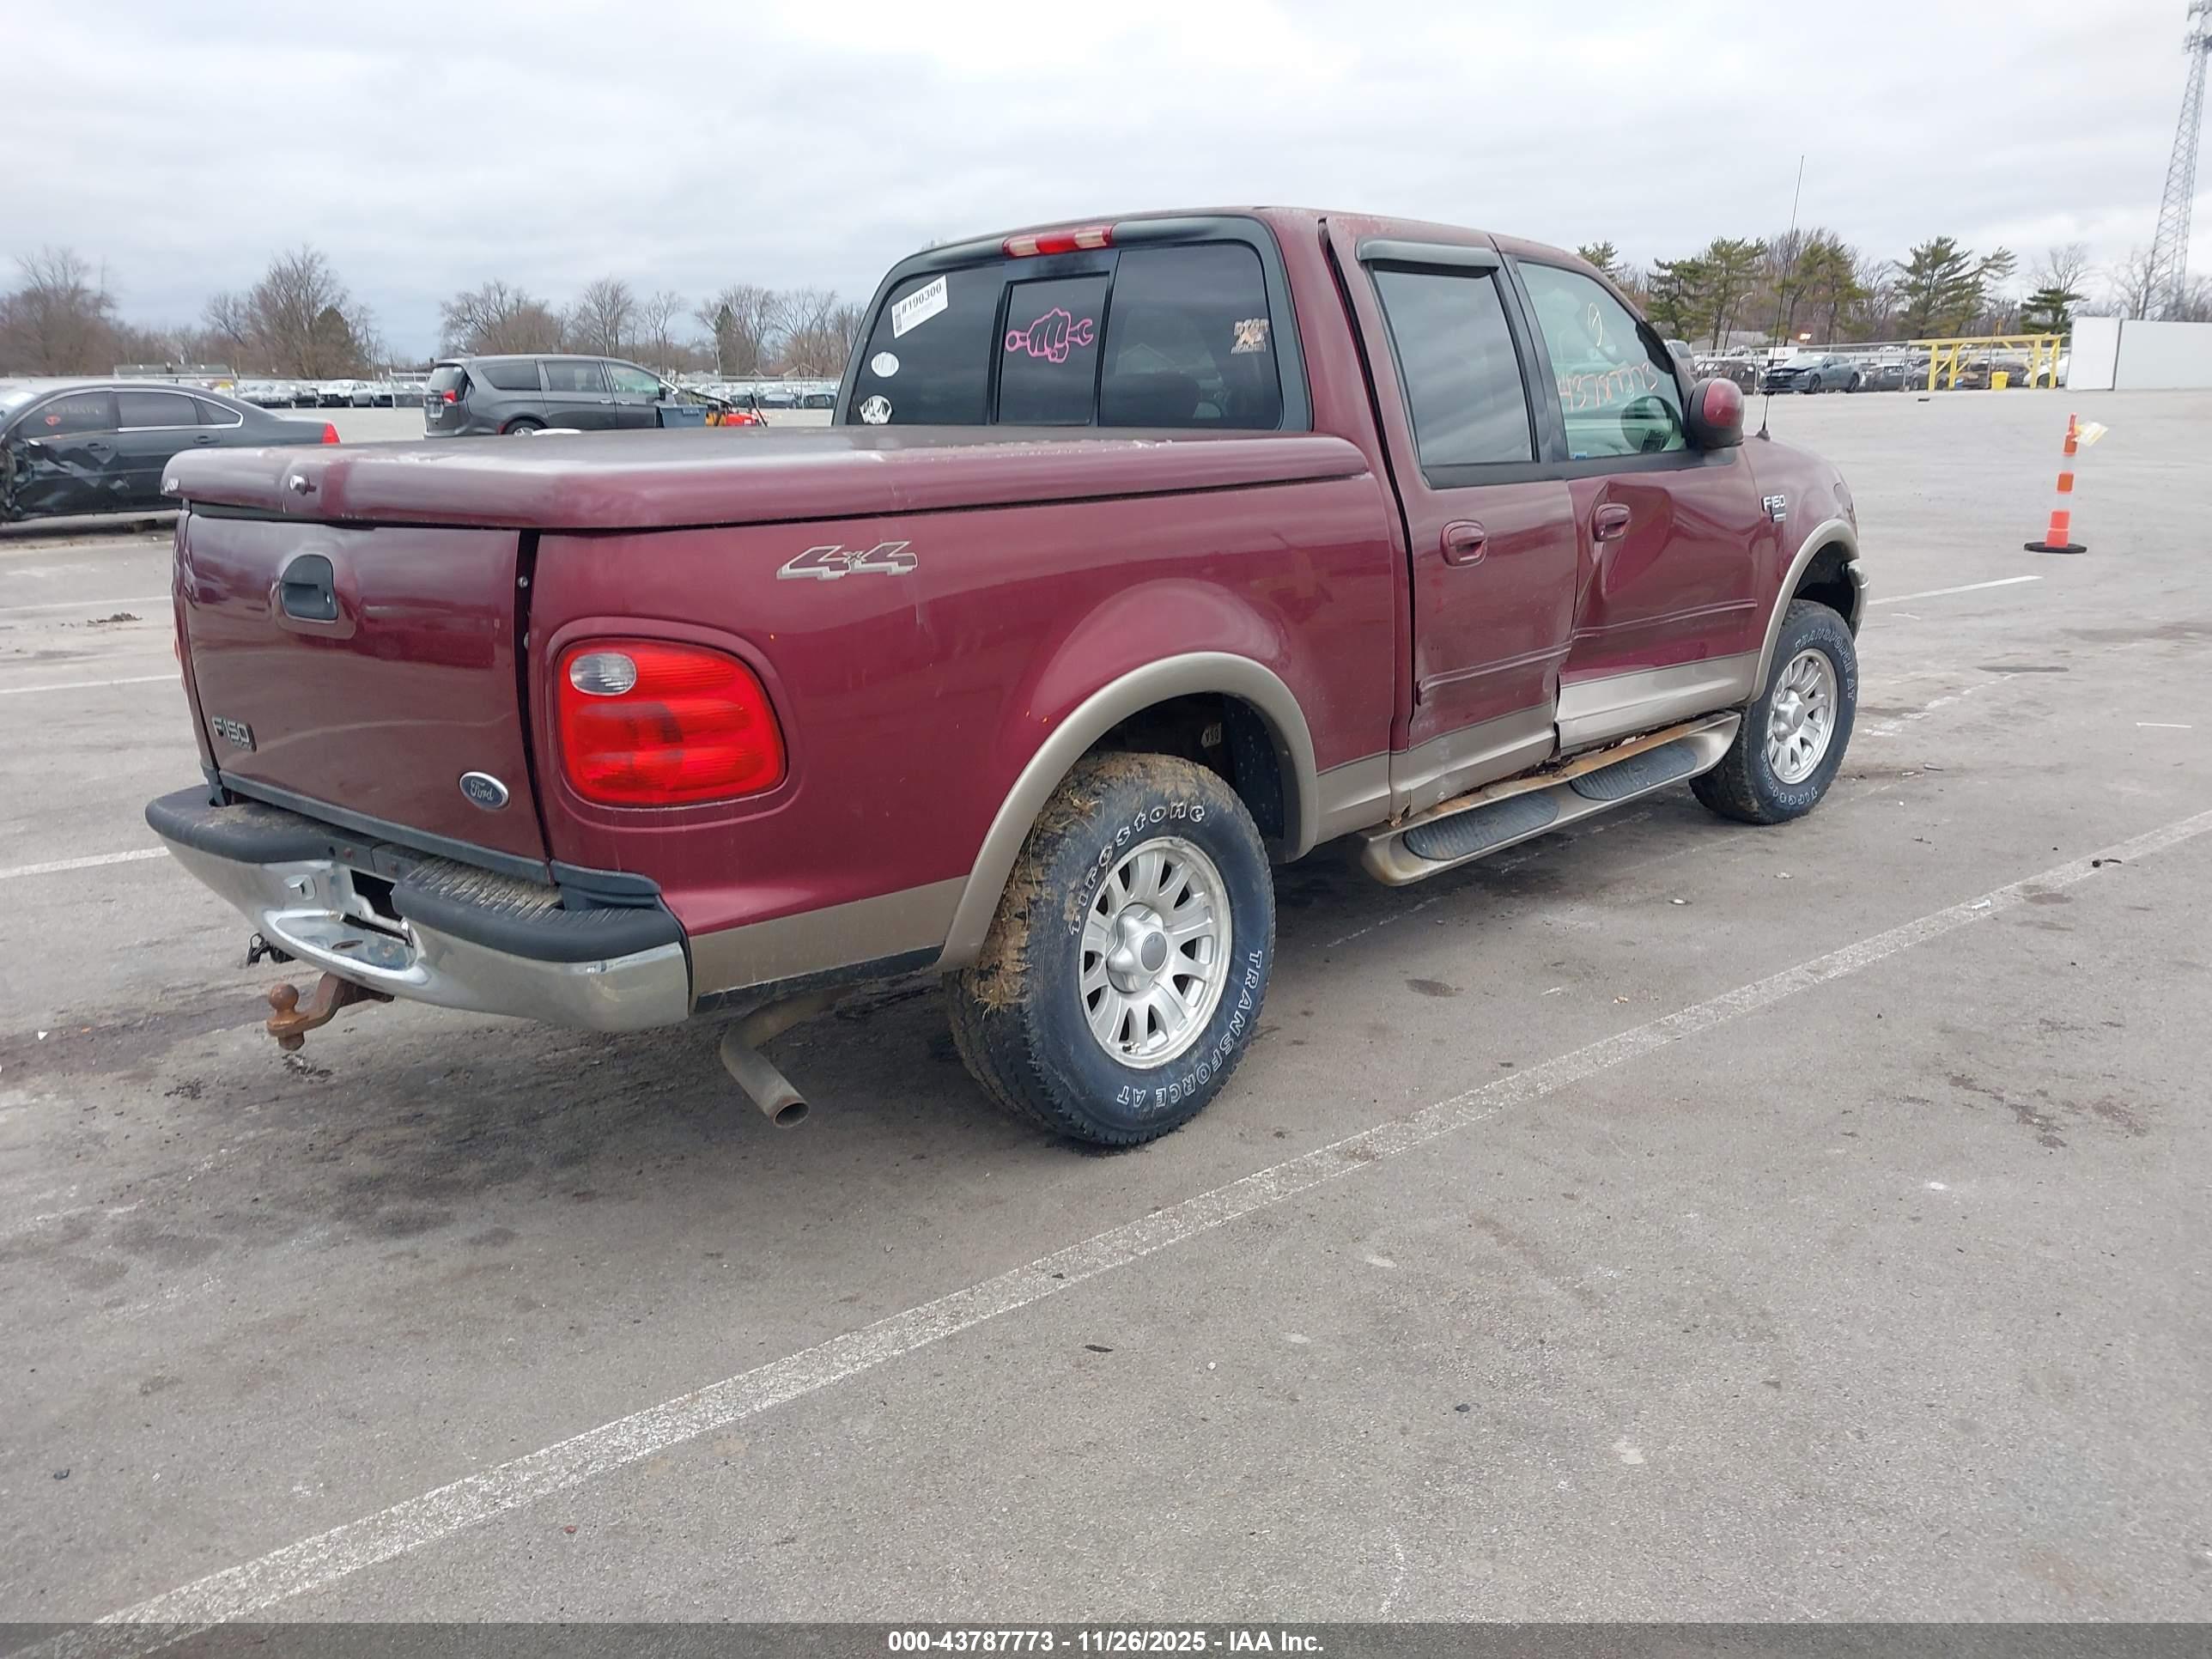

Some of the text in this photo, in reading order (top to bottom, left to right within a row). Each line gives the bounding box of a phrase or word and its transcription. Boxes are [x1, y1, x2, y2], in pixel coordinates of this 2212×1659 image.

[776, 540, 921, 580] 4x4
[471, 780, 495, 800] Ford
[1116, 950, 1262, 1108] TRANSFORCE AT
